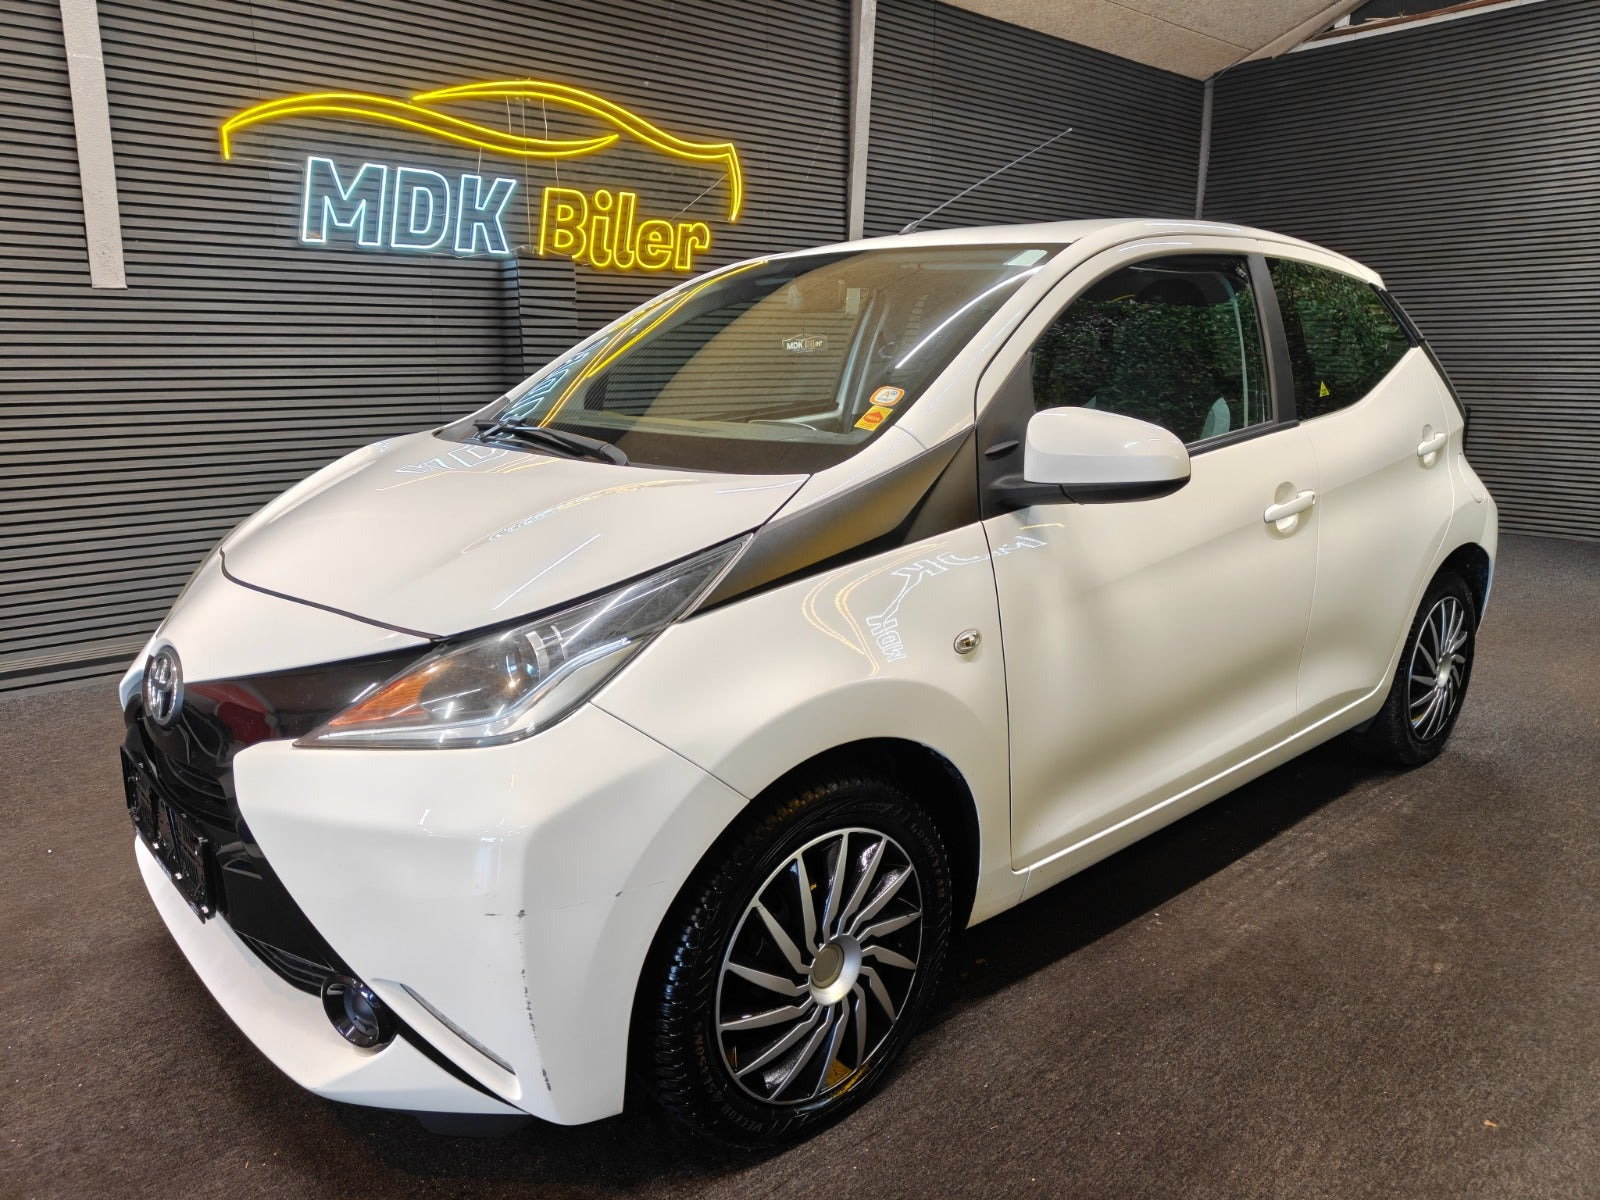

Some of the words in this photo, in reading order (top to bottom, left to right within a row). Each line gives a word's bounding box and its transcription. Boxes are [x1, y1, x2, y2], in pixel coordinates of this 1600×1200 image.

[301, 155, 517, 255] MDK
[538, 186, 711, 271] Biler
[786, 341, 803, 350] MDK
